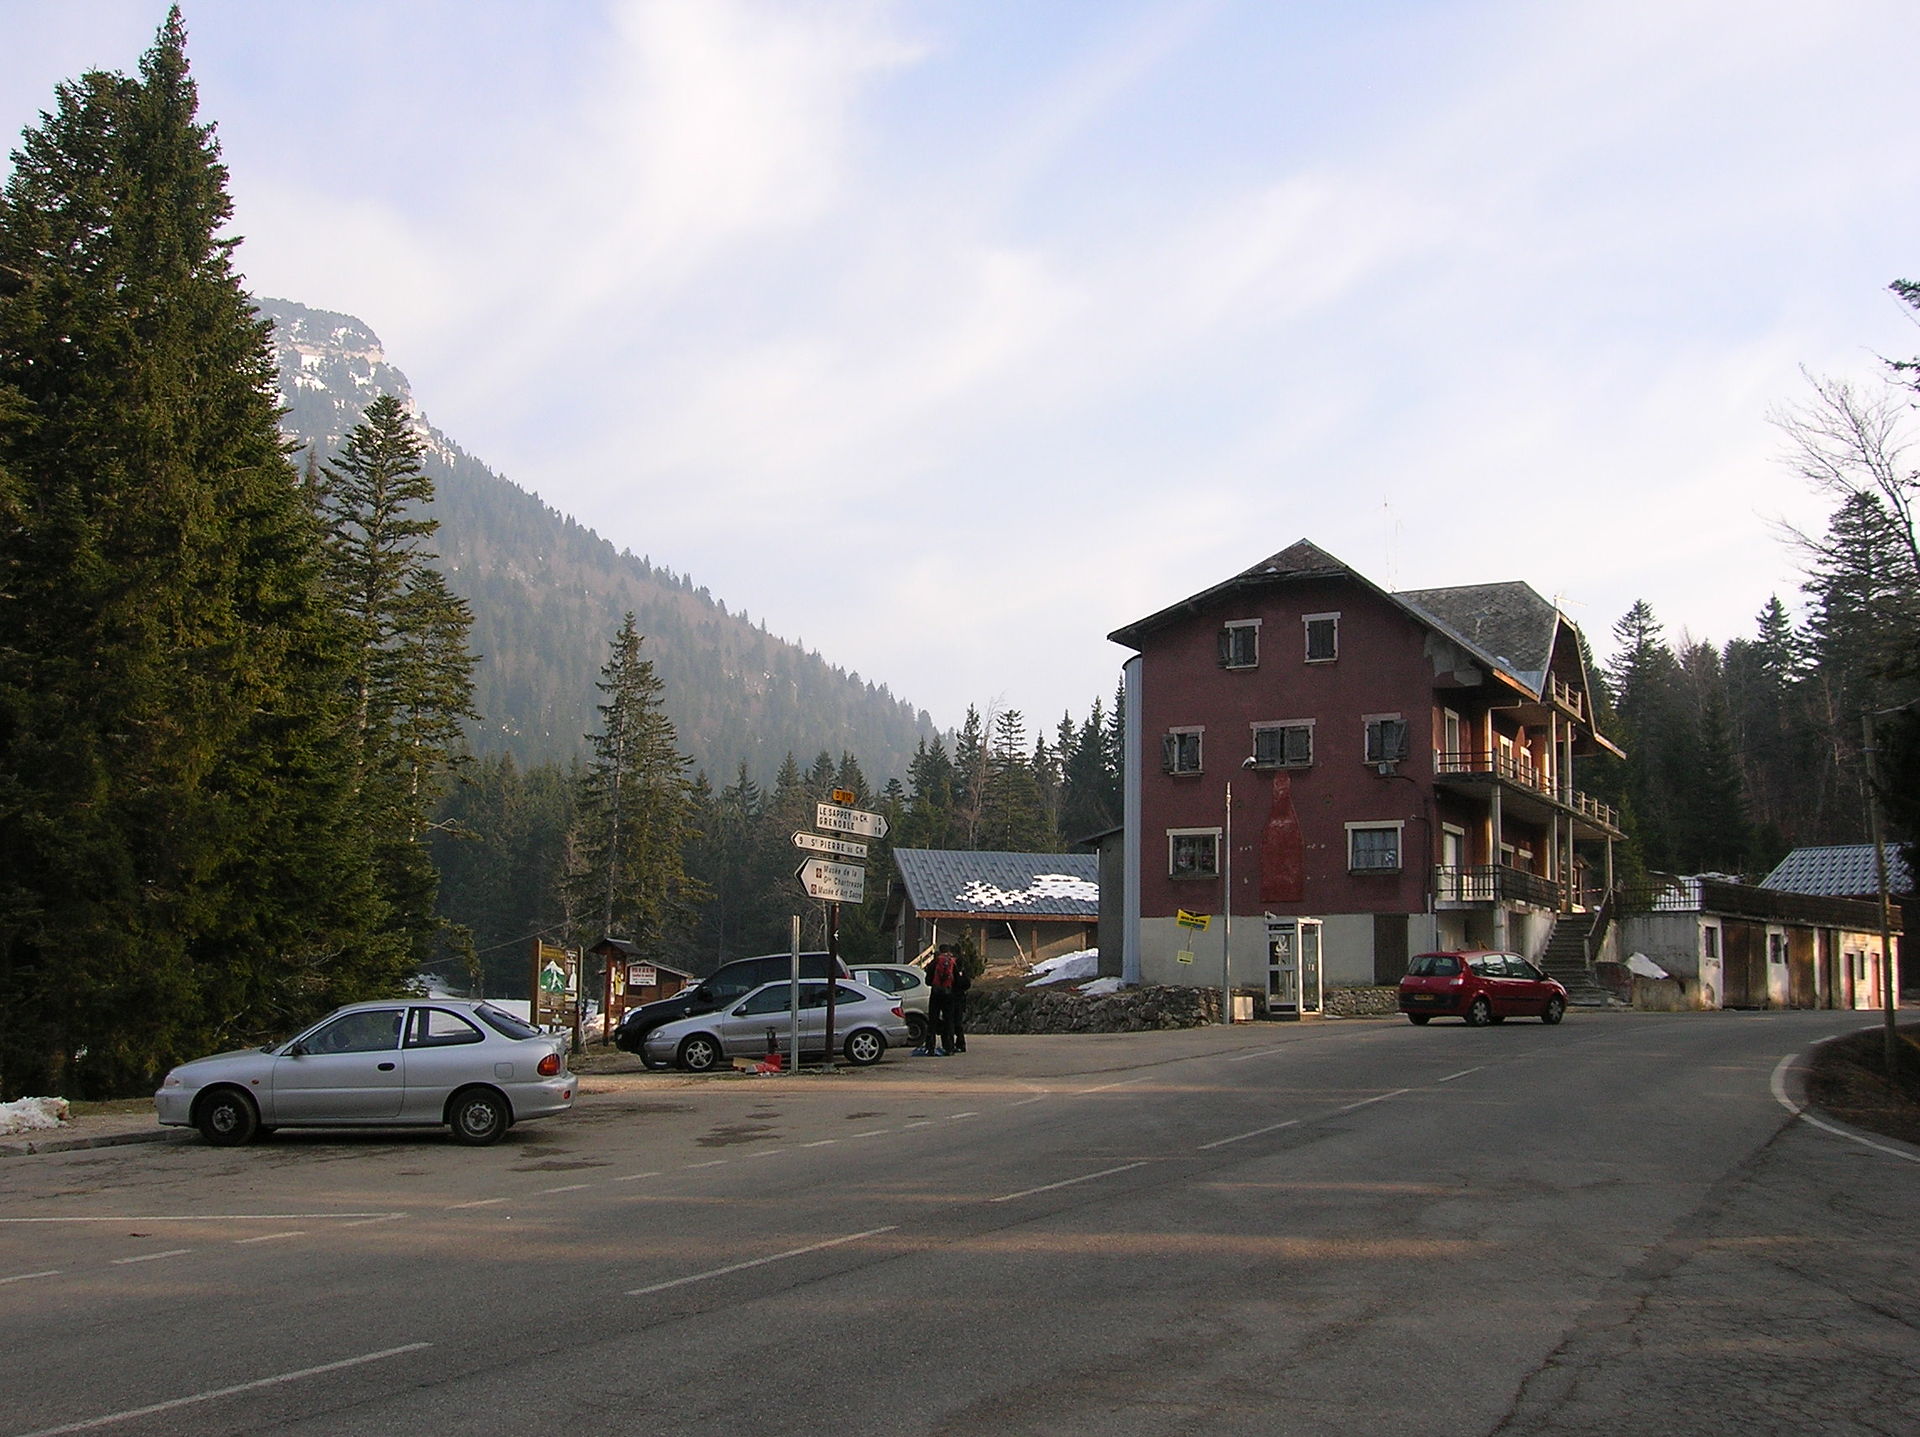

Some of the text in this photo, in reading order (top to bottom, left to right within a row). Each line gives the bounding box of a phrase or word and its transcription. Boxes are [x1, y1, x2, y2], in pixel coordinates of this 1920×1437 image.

[820, 807, 827, 816] LE
[828, 808, 851, 820] SAPPEY
[819, 817, 855, 831] GRENOBLE
[799, 836, 804, 845] 9
[820, 840, 845, 852] PIERRE
[833, 876, 863, 889] Chartreuse
